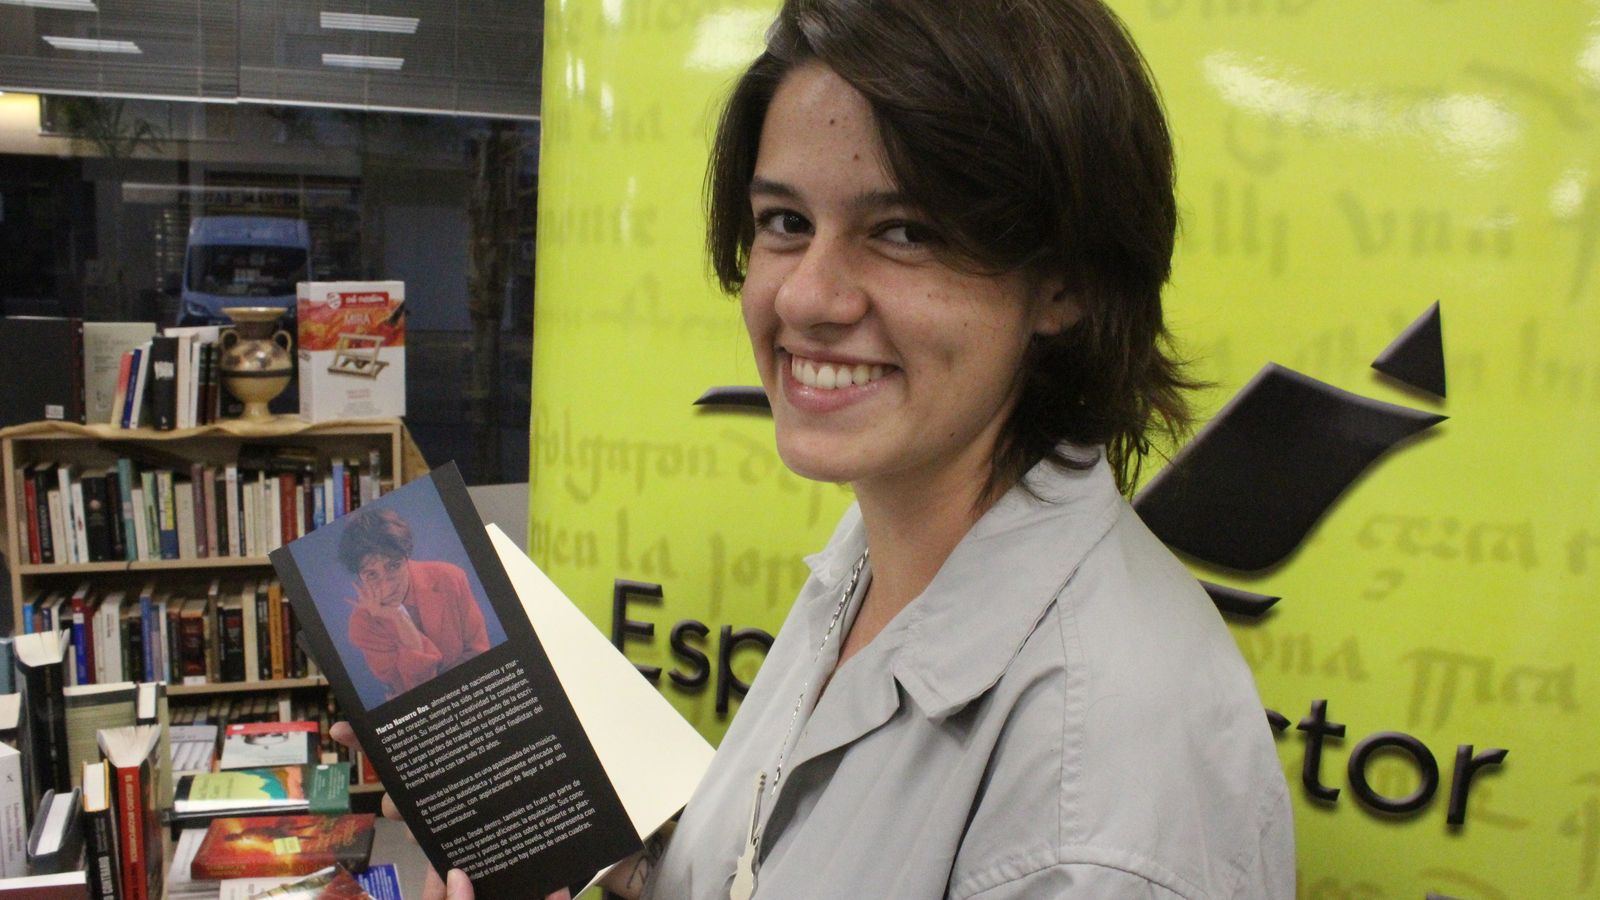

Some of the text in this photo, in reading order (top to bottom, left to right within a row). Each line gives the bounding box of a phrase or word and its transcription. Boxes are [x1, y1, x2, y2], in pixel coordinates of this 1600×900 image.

[376, 723, 393, 734] Marta
[393, 711, 417, 725] Navarro
[431, 689, 460, 707] almeriense
[461, 684, 469, 692] de
[469, 669, 500, 687] nacimiento
[505, 660, 518, 669] mur-
[381, 733, 397, 744] ciana
[429, 705, 451, 720] siempre
[460, 695, 472, 704] sido
[473, 689, 484, 697] una
[485, 673, 516, 691] apasionada
[428, 715, 453, 732] inquietud
[459, 697, 489, 716] creatividad
[391, 751, 407, 762] desde
[408, 745, 418, 754] una
[418, 732, 445, 748] temprana
[460, 716, 476, 727] hacia
[476, 711, 482, 719] el
[483, 703, 502, 716] mundo
[407, 764, 428, 777] llevaron
[434, 744, 468, 765] posicionarse
[469, 736, 484, 746] entre
[495, 724, 506, 733] diez
[507, 711, 533, 726] finalistas
[533, 705, 543, 714] del
[408, 753, 427, 765] Largas
[427, 744, 445, 755] tardes
[452, 730, 472, 742] trabajo
[505, 697, 537, 716] adolescente
[405, 777, 425, 789] Premio
[424, 767, 445, 779] Planeta
[445, 762, 456, 770] con
[465, 751, 477, 760] solo
[477, 745, 485, 754] 20
[456, 780, 487, 798] autodidacta
[493, 761, 526, 780] actualmente
[527, 747, 553, 763] enfocada
[479, 780, 512, 799] aspiraciones
[521, 767, 537, 777] llegar
[544, 758, 553, 766] ser
[555, 752, 566, 761] una
[481, 766, 492, 775] una
[492, 751, 523, 769] apasionada
[1266, 699, 1509, 826] tor
[474, 833, 496, 847] grandes
[557, 797, 569, 806] Sus
[569, 790, 584, 800] cono-
[533, 796, 548, 806] fruto
[557, 784, 572, 796] parte
[431, 823, 447, 833] buena
[481, 843, 500, 855] puntos
[508, 832, 522, 841] vista
[523, 824, 538, 834] sobre
[545, 810, 567, 824] deporte
[512, 842, 524, 851] esta
[543, 828, 554, 836] que
[554, 813, 584, 830] representa
[584, 808, 595, 816] con
[489, 861, 508, 872] trabajo
[508, 857, 518, 865] que
[554, 833, 568, 842] unas
